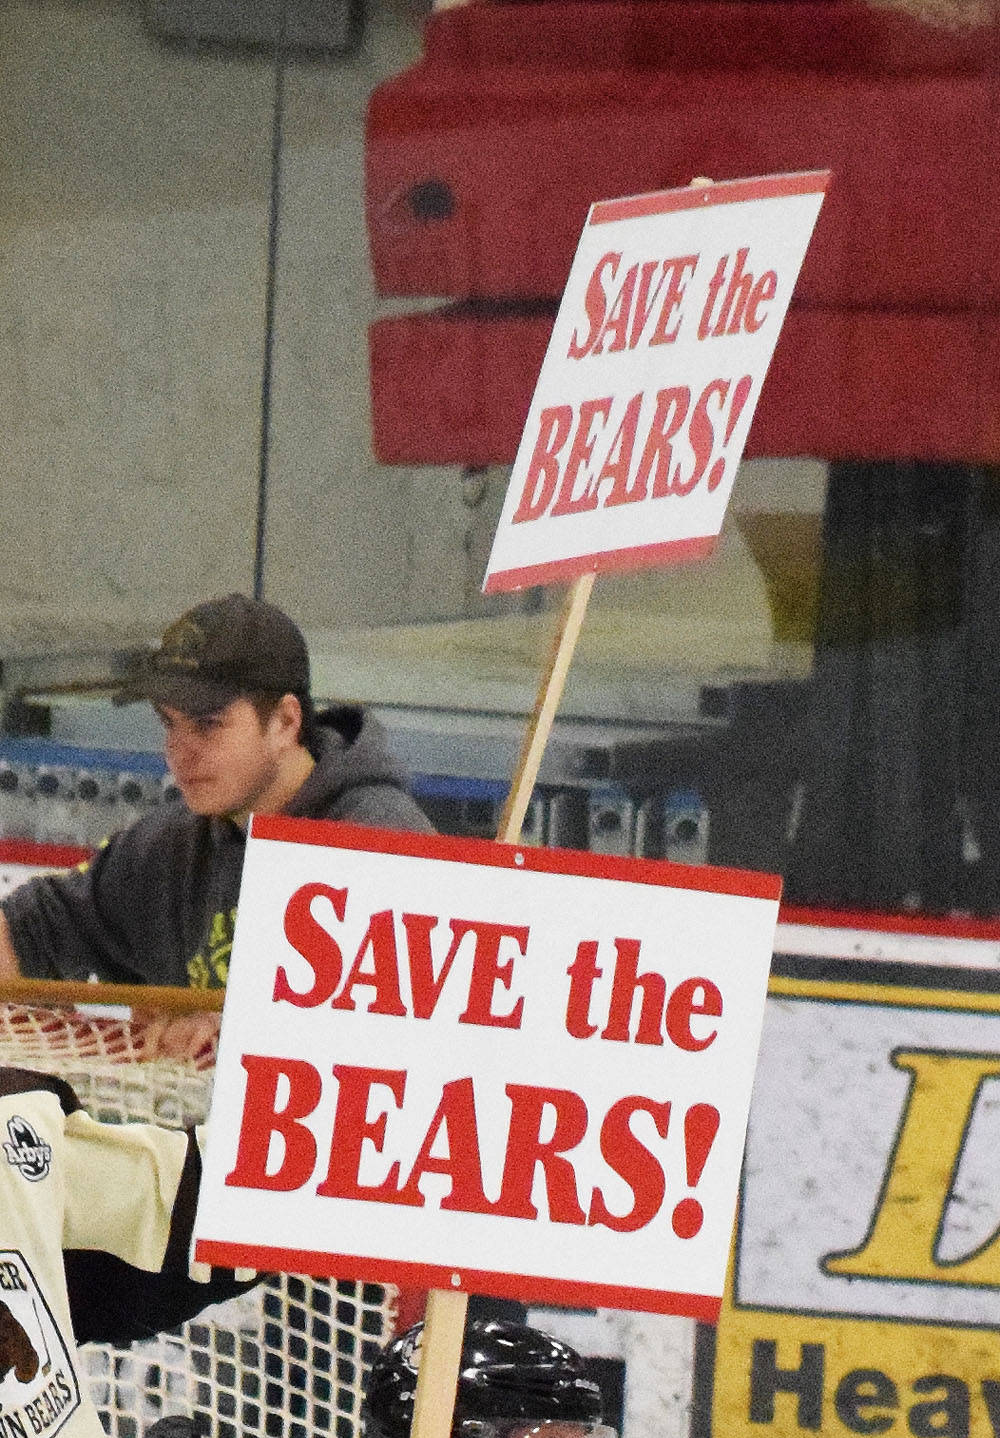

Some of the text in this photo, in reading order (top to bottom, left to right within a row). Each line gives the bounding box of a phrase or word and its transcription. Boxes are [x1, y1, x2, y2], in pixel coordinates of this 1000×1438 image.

[567, 247, 779, 359] SAVE the
[512, 374, 752, 525] BEARS!
[273, 882, 530, 1031] SAVE
[566, 938, 723, 1052] the
[225, 1053, 721, 1240] BEARS!
[25, 1369, 72, 1435] BEARS
